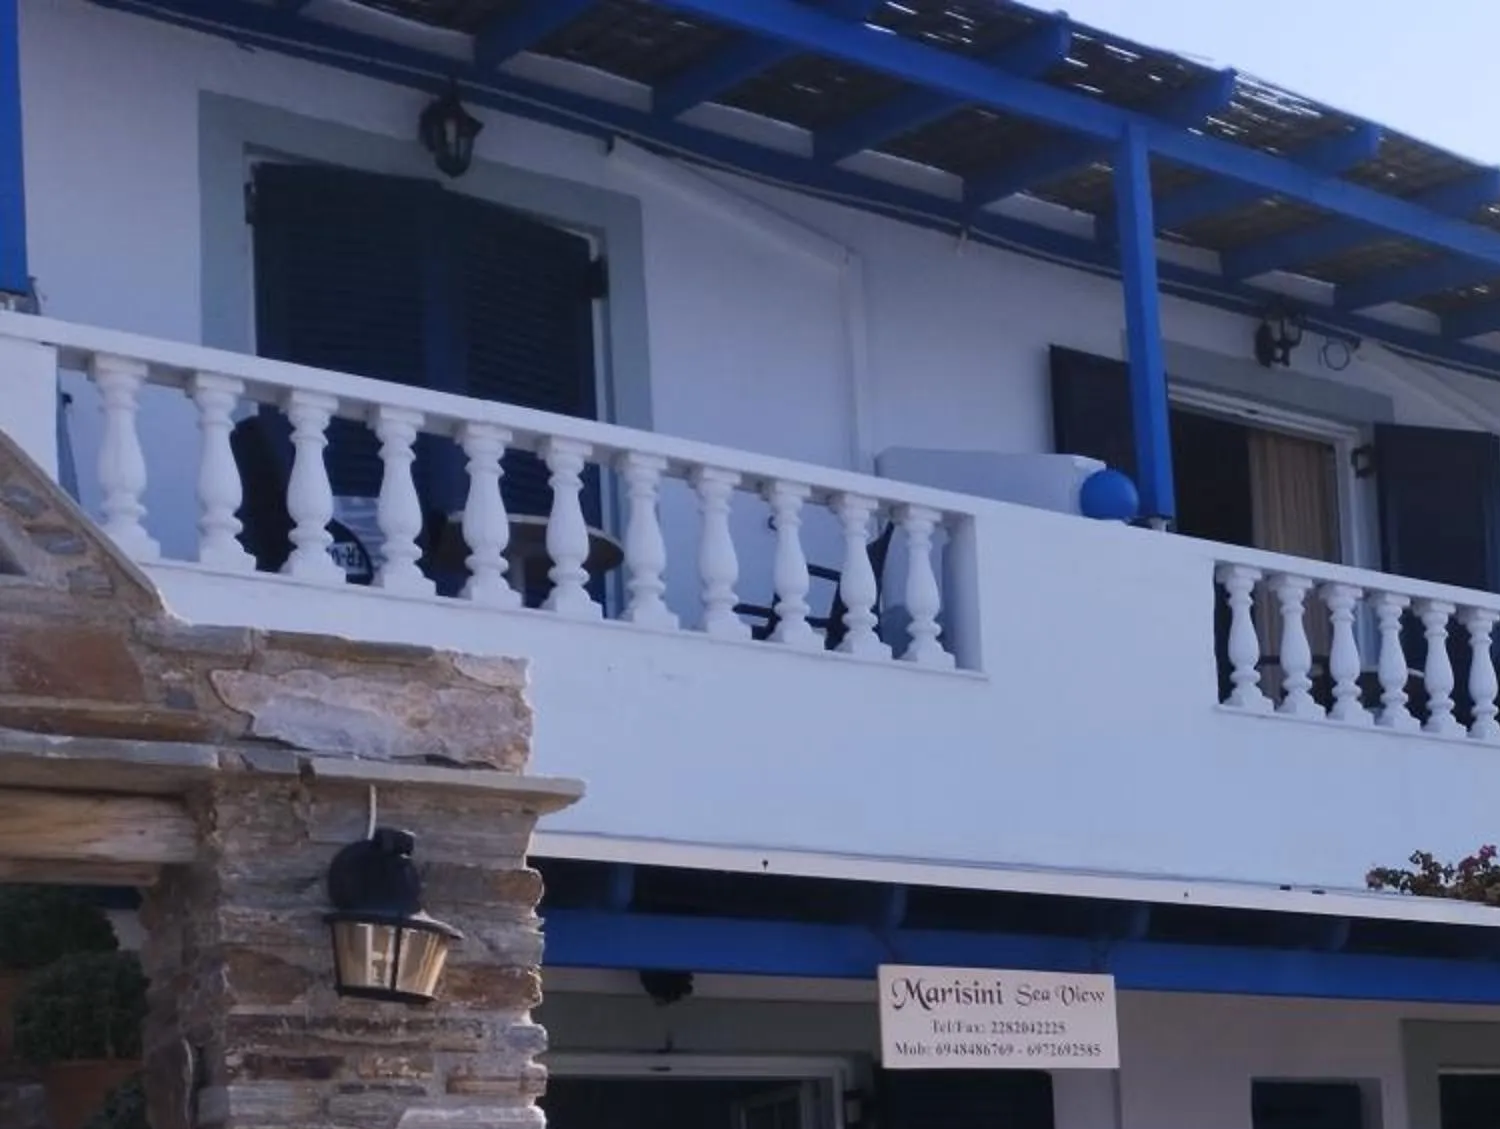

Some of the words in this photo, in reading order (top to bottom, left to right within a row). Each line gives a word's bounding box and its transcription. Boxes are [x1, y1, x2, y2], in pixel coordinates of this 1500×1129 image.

[891, 977, 1003, 1011] Marisini
[1015, 983, 1050, 1007] Sea
[1054, 985, 1105, 1007] View
[991, 1020, 1066, 1036] 2282042225
[895, 1041, 927, 1057] Mob:
[935, 1041, 1014, 1057] 6948486769
[1027, 1042, 1102, 1058] 6972692585
